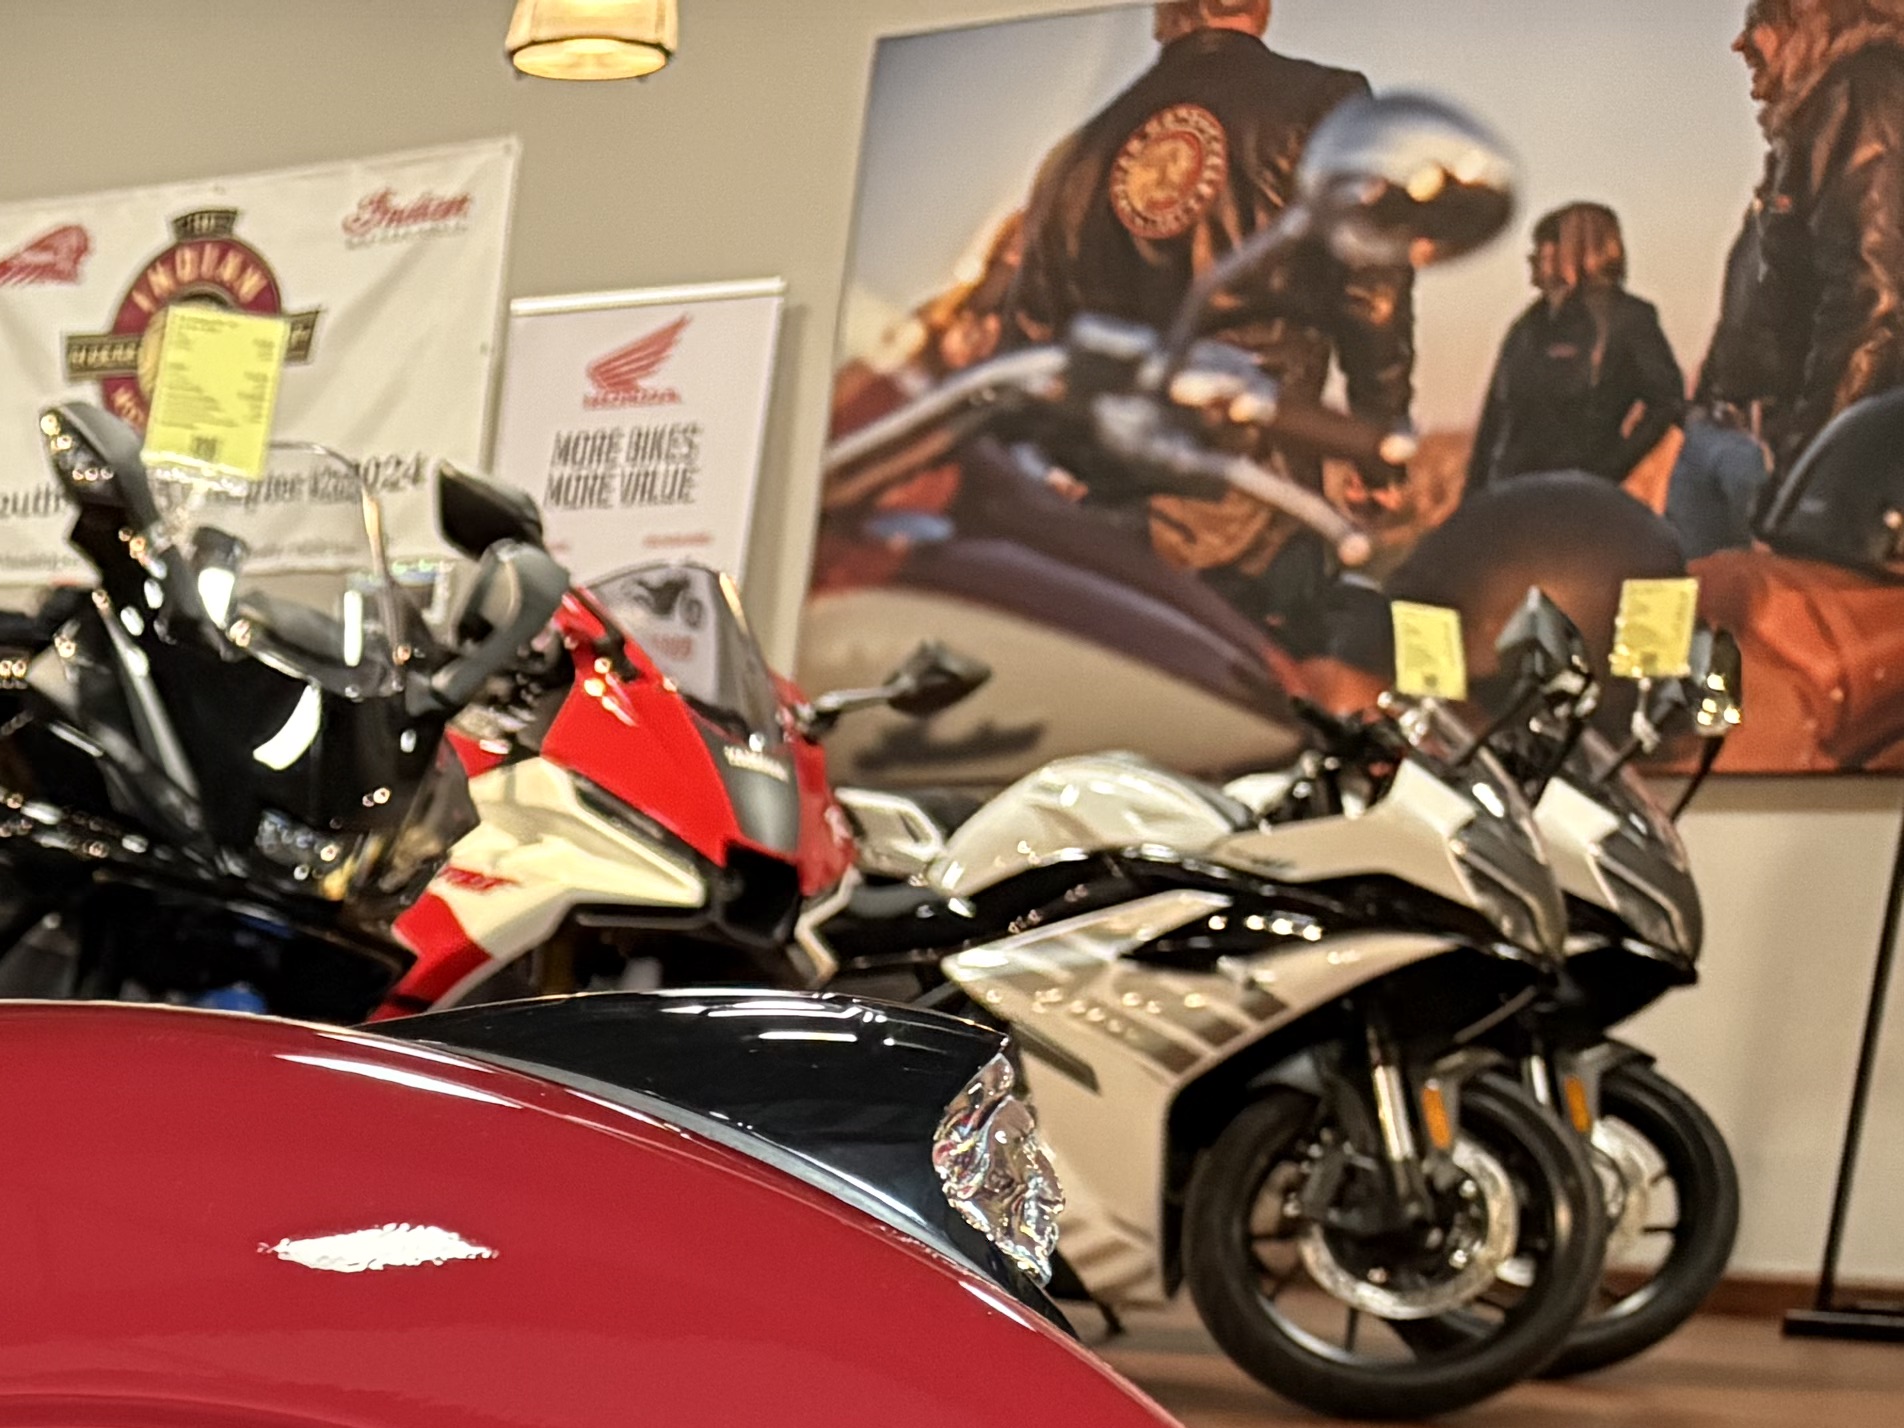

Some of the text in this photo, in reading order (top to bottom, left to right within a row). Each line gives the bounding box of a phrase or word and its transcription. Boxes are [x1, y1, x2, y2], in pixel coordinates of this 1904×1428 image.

[552, 421, 702, 468] MORE BIKES
[543, 470, 617, 511] MORE
